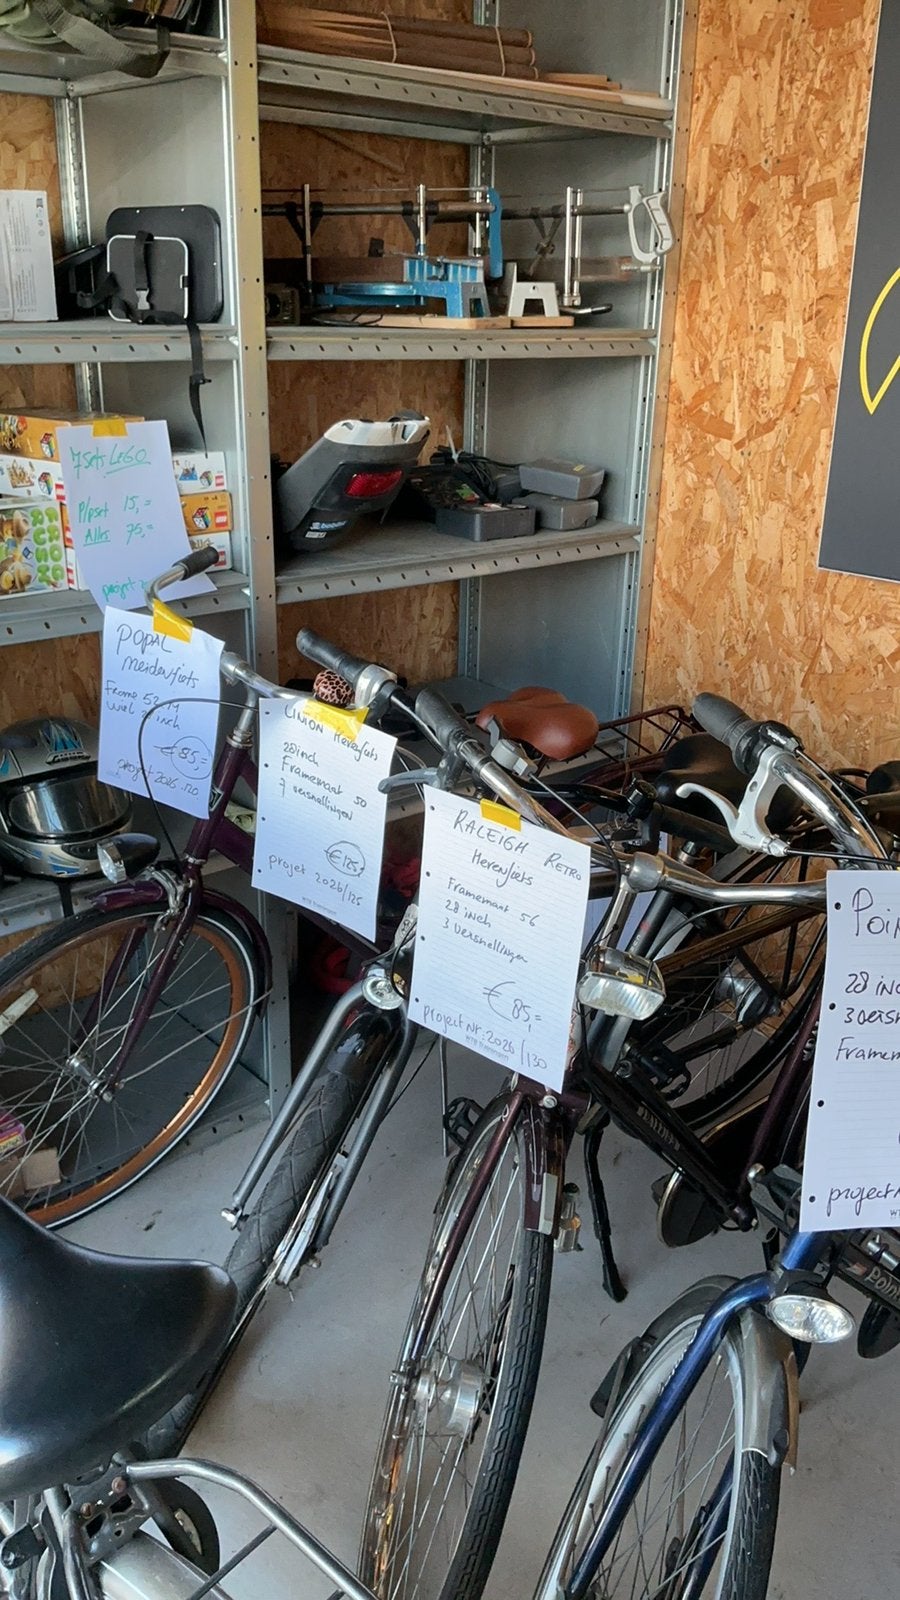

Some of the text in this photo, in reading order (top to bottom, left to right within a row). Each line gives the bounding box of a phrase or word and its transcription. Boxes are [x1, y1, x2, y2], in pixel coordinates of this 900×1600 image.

[352, 795, 367, 808] 50
[445, 899, 460, 914] 28
[442, 917, 450, 929] 3
[519, 912, 540, 927] 56
[845, 971, 869, 994] 28
[844, 1007, 855, 1025] 3
